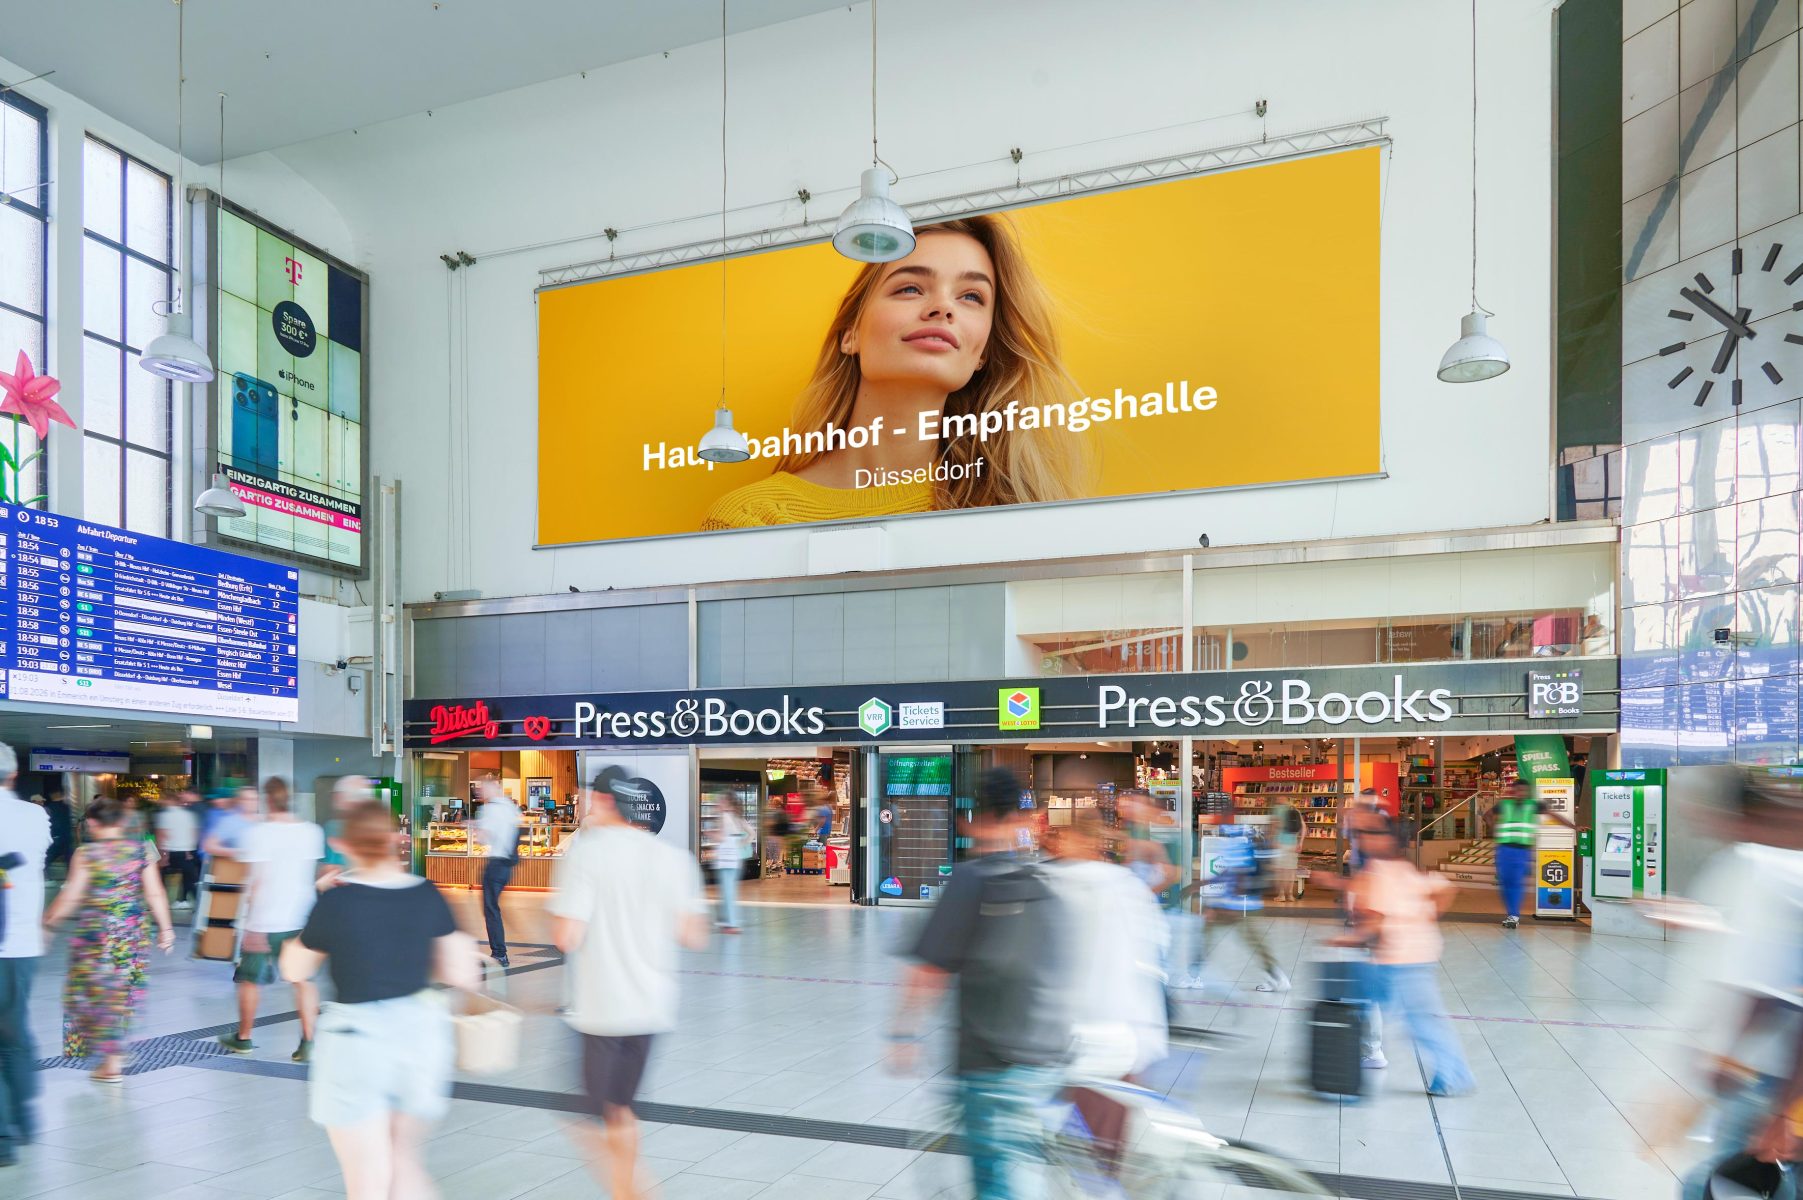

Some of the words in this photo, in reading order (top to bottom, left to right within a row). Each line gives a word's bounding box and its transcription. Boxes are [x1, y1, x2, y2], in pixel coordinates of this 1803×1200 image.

[283, 312, 306, 329] Spare
[281, 322, 297, 337] 300
[286, 371, 315, 390] iPhone
[643, 416, 884, 471] Haubahnhof
[918, 381, 1217, 442] Empfangshalle
[856, 457, 984, 489] Düsseldorf
[226, 469, 297, 497] EINZIGARTIG
[299, 490, 356, 515] ZUSAMMEN
[275, 499, 334, 523] ZUSAMMEN
[77, 525, 104, 538] Abfahrt
[105, 531, 138, 546] Departure
[18, 540, 39, 551] 18:54
[18, 553, 39, 564] 18:54
[18, 567, 39, 578] 18:55
[18, 580, 39, 591] 18:56
[18, 593, 39, 604] 18:57
[18, 607, 39, 617] 18:58
[218, 603, 232, 612] Essen
[233, 605, 242, 613] Hbf
[218, 614, 236, 623] Minden
[18, 620, 39, 630] 18:58
[18, 633, 39, 643] 18:58
[18, 647, 39, 657] 19:02
[17, 660, 39, 669] 19:03
[217, 659, 237, 668] Koblenz
[238, 661, 247, 669] Hbf
[217, 670, 232, 678] Essen
[232, 672, 242, 680] Hbf
[217, 681, 233, 690] Wesel
[1533, 682, 1580, 705] P&B
[903, 706, 940, 716] Tickets
[430, 700, 489, 735] Ditsch
[903, 716, 940, 726] Service
[1523, 752, 1552, 762] SPIELE.
[1269, 767, 1316, 779] Bestseller
[1532, 764, 1560, 773] SPASS.
[1602, 792, 1631, 800] Tickets
[1547, 869, 1563, 882] 50
